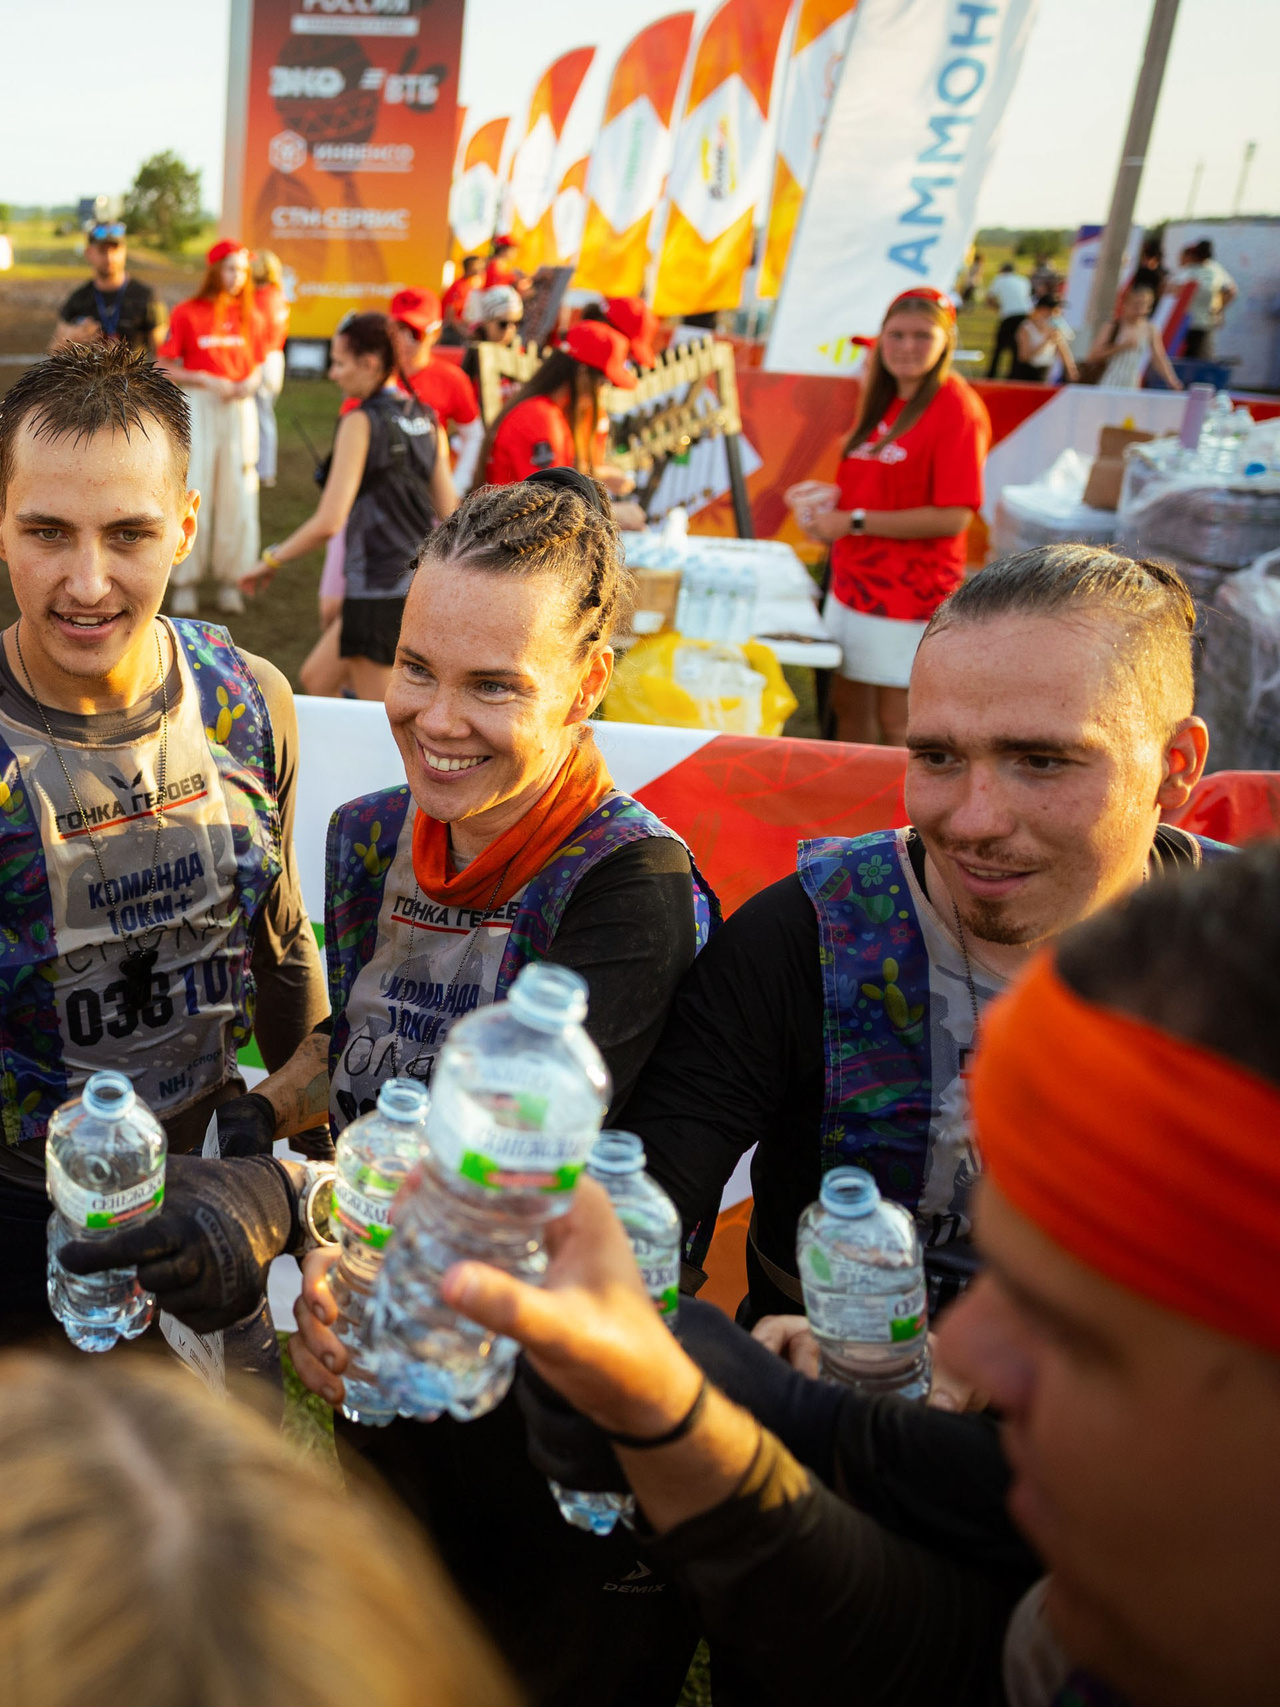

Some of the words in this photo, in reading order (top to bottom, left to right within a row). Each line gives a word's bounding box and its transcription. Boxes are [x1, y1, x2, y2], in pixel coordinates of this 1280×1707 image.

[888, 2, 998, 276] АММОН
[56, 802, 127, 833] ГОНКА
[131, 773, 206, 812] ГЕРОЕВ
[87, 852, 204, 910] КОМАНДА
[106, 893, 193, 936] 10КМ+
[393, 896, 450, 926] ГОНКА
[66, 971, 174, 1046] 036
[387, 1006, 448, 1045] 10КМ
[602, 1582, 666, 1593] DEMIX
